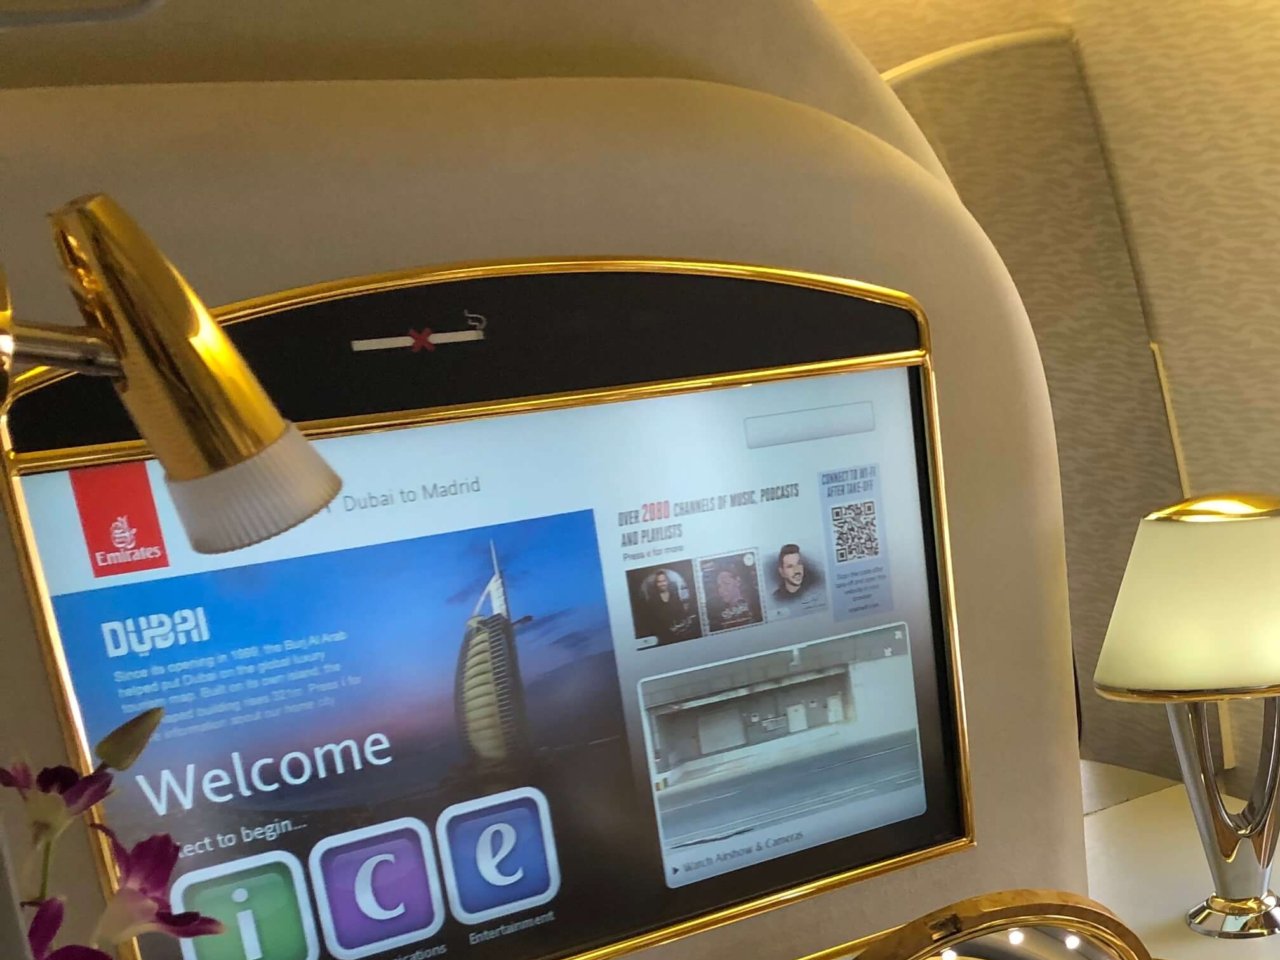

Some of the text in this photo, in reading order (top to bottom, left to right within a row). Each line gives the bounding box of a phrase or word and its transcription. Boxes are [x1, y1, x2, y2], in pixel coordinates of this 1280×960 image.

[342, 476, 481, 512] Dubai to Madrid
[617, 509, 641, 527] OVER
[673, 497, 716, 518] CHANNELS
[717, 494, 728, 510] OF
[760, 483, 800, 503] PODCASTS
[620, 523, 683, 548] AND PLAYLISTS
[95, 546, 162, 567] Emirates
[101, 606, 211, 658] DUBAI
[135, 732, 393, 817] Welcome
[216, 832, 237, 848] to
[765, 831, 804, 848] Cameras
[468, 911, 555, 945] Entertainment
